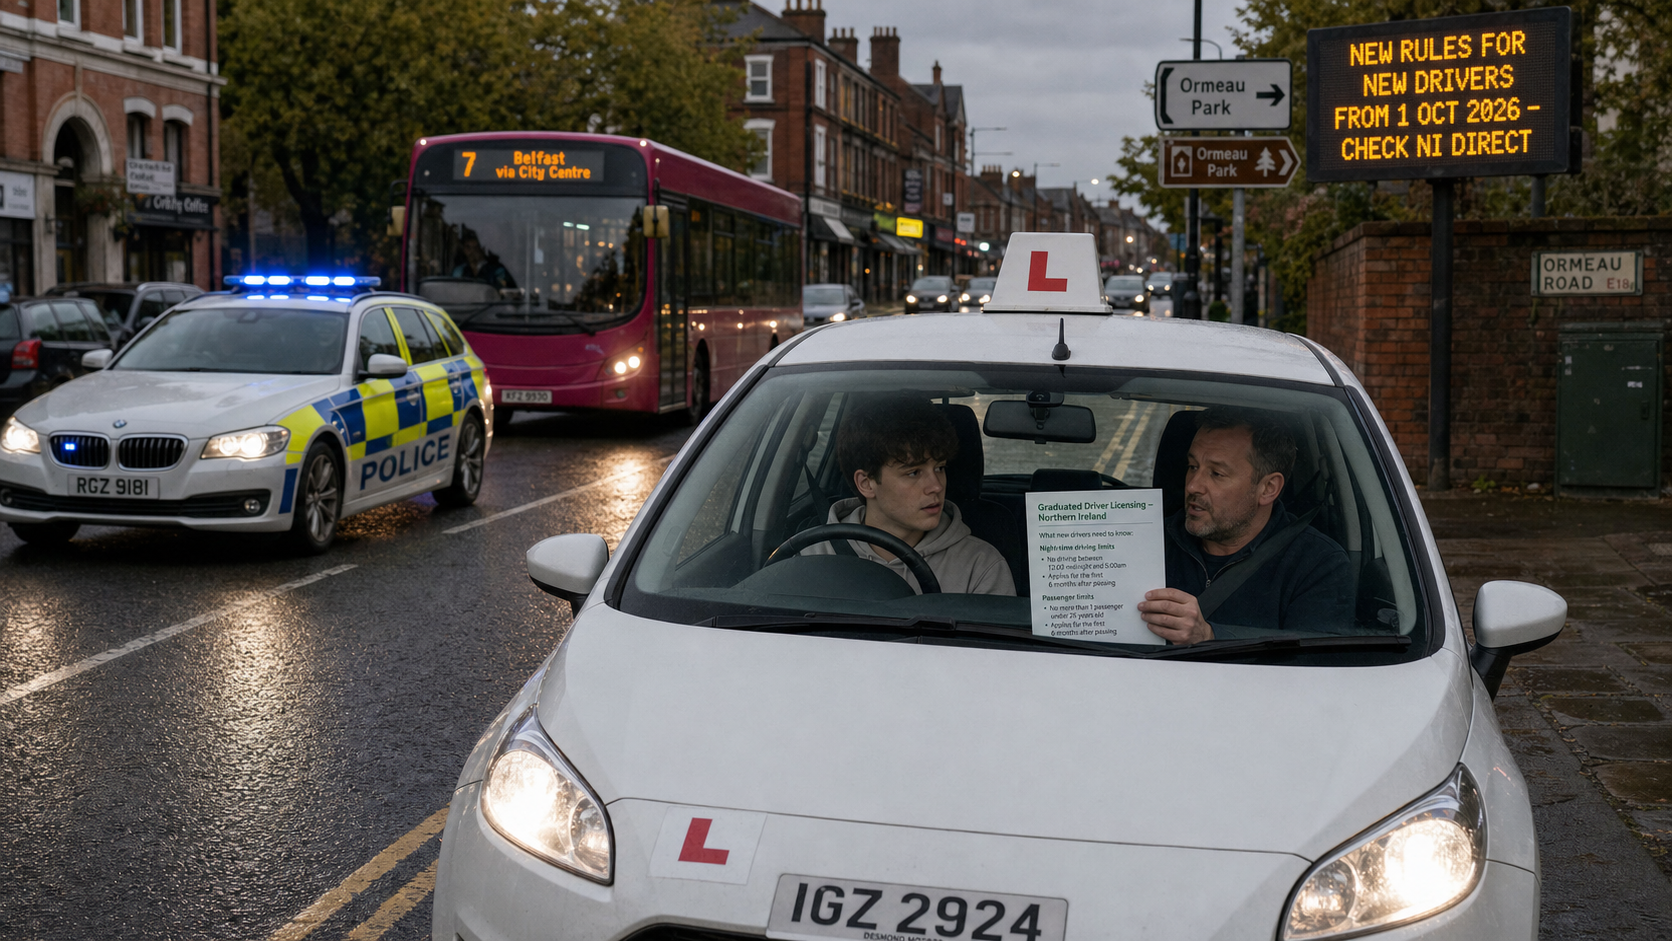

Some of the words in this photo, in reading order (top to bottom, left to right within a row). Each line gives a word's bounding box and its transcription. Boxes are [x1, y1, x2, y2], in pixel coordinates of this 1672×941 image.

[1350, 41, 1393, 66] NEW
[1400, 35, 1472, 62] RULES
[1481, 30, 1526, 57] FOR
[1180, 78, 1245, 92] Ormeau
[1363, 72, 1408, 96] NEW
[1415, 64, 1514, 94] DRIVERS
[1192, 100, 1231, 115] Park
[1334, 104, 1390, 130] FROM
[1397, 103, 1410, 127] 1
[1417, 100, 1459, 125] OCT
[1466, 97, 1520, 123] 2026
[1341, 135, 1409, 160] CHECK
[1416, 134, 1442, 158] NI
[1451, 129, 1532, 157] DIRECT
[514, 150, 566, 166] Belfast
[1196, 147, 1248, 160] Ormeau
[462, 152, 476, 178] 7
[1207, 164, 1237, 177] Park
[496, 166, 516, 178] via
[518, 166, 545, 181] City
[549, 166, 591, 179] Centre
[1028, 251, 1068, 292] L
[1544, 257, 1622, 272] ORMEAU
[1544, 276, 1593, 290] ROAD
[360, 434, 450, 490] POLICE
[76, 478, 110, 496] RGZ
[115, 478, 149, 496] 9181
[1084, 502, 1108, 510] Driver
[1110, 501, 1146, 510] Licensing
[1038, 513, 1076, 522] Northern
[1078, 512, 1106, 520] Ireland
[1074, 544, 1096, 552] driving
[1042, 594, 1075, 602] Passenger
[678, 817, 730, 865] L
[791, 882, 883, 930] IGZ
[896, 892, 1042, 941] 2924
